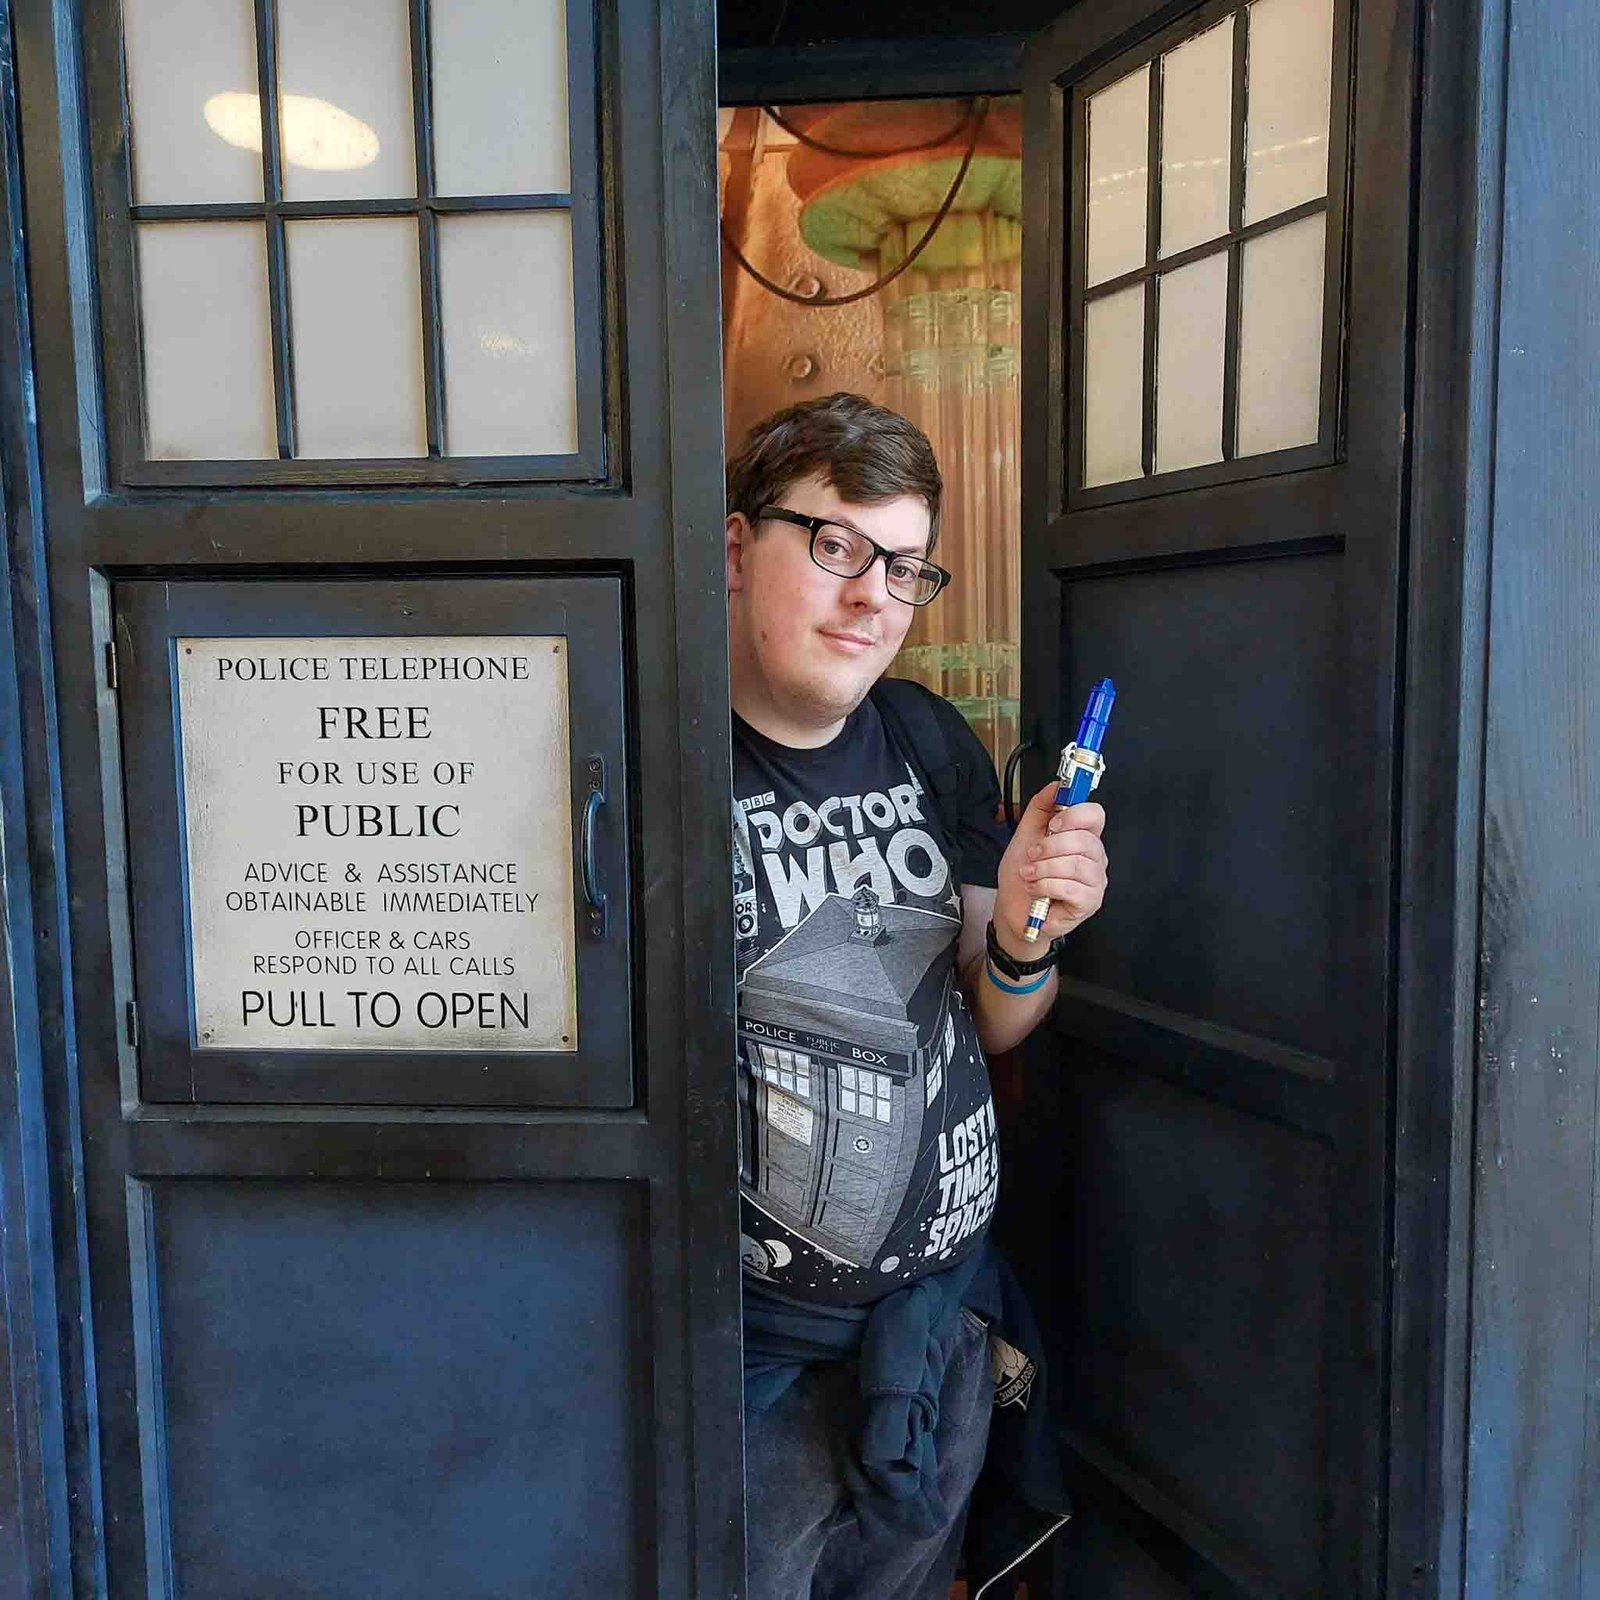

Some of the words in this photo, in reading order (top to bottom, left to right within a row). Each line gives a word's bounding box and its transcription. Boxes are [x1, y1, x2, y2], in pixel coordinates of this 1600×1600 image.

[216, 657, 330, 681] POLICE
[339, 656, 530, 681] TELEPHONE
[316, 706, 432, 740] FREE
[277, 761, 344, 785] FOR
[355, 761, 420, 785] USE
[433, 761, 475, 785] OF
[740, 791, 776, 811] BBC
[295, 804, 462, 838] PUBLIC
[748, 783, 927, 850] DOCTOR
[244, 862, 329, 883] ADVICE
[344, 862, 362, 884] &
[377, 863, 518, 884] ASSISTANCE
[761, 828, 949, 929] WHO
[225, 891, 367, 912] OBTAINABLE
[383, 892, 540, 913] IMMEDIATELY
[294, 930, 381, 950] OFFICER
[388, 930, 406, 950] &
[413, 930, 471, 950] CARS
[253, 955, 357, 975] RESPOND
[364, 956, 395, 976] TO
[403, 956, 441, 976] ALL
[449, 956, 516, 976] CALLS
[241, 990, 337, 1028] PULL
[346, 991, 401, 1029] TO
[416, 992, 530, 1030] OPEN
[745, 1020, 797, 1043] POLICE
[852, 1047, 888, 1066] BOX
[938, 1104, 987, 1174] LOST
[938, 1146, 990, 1215] TIME
